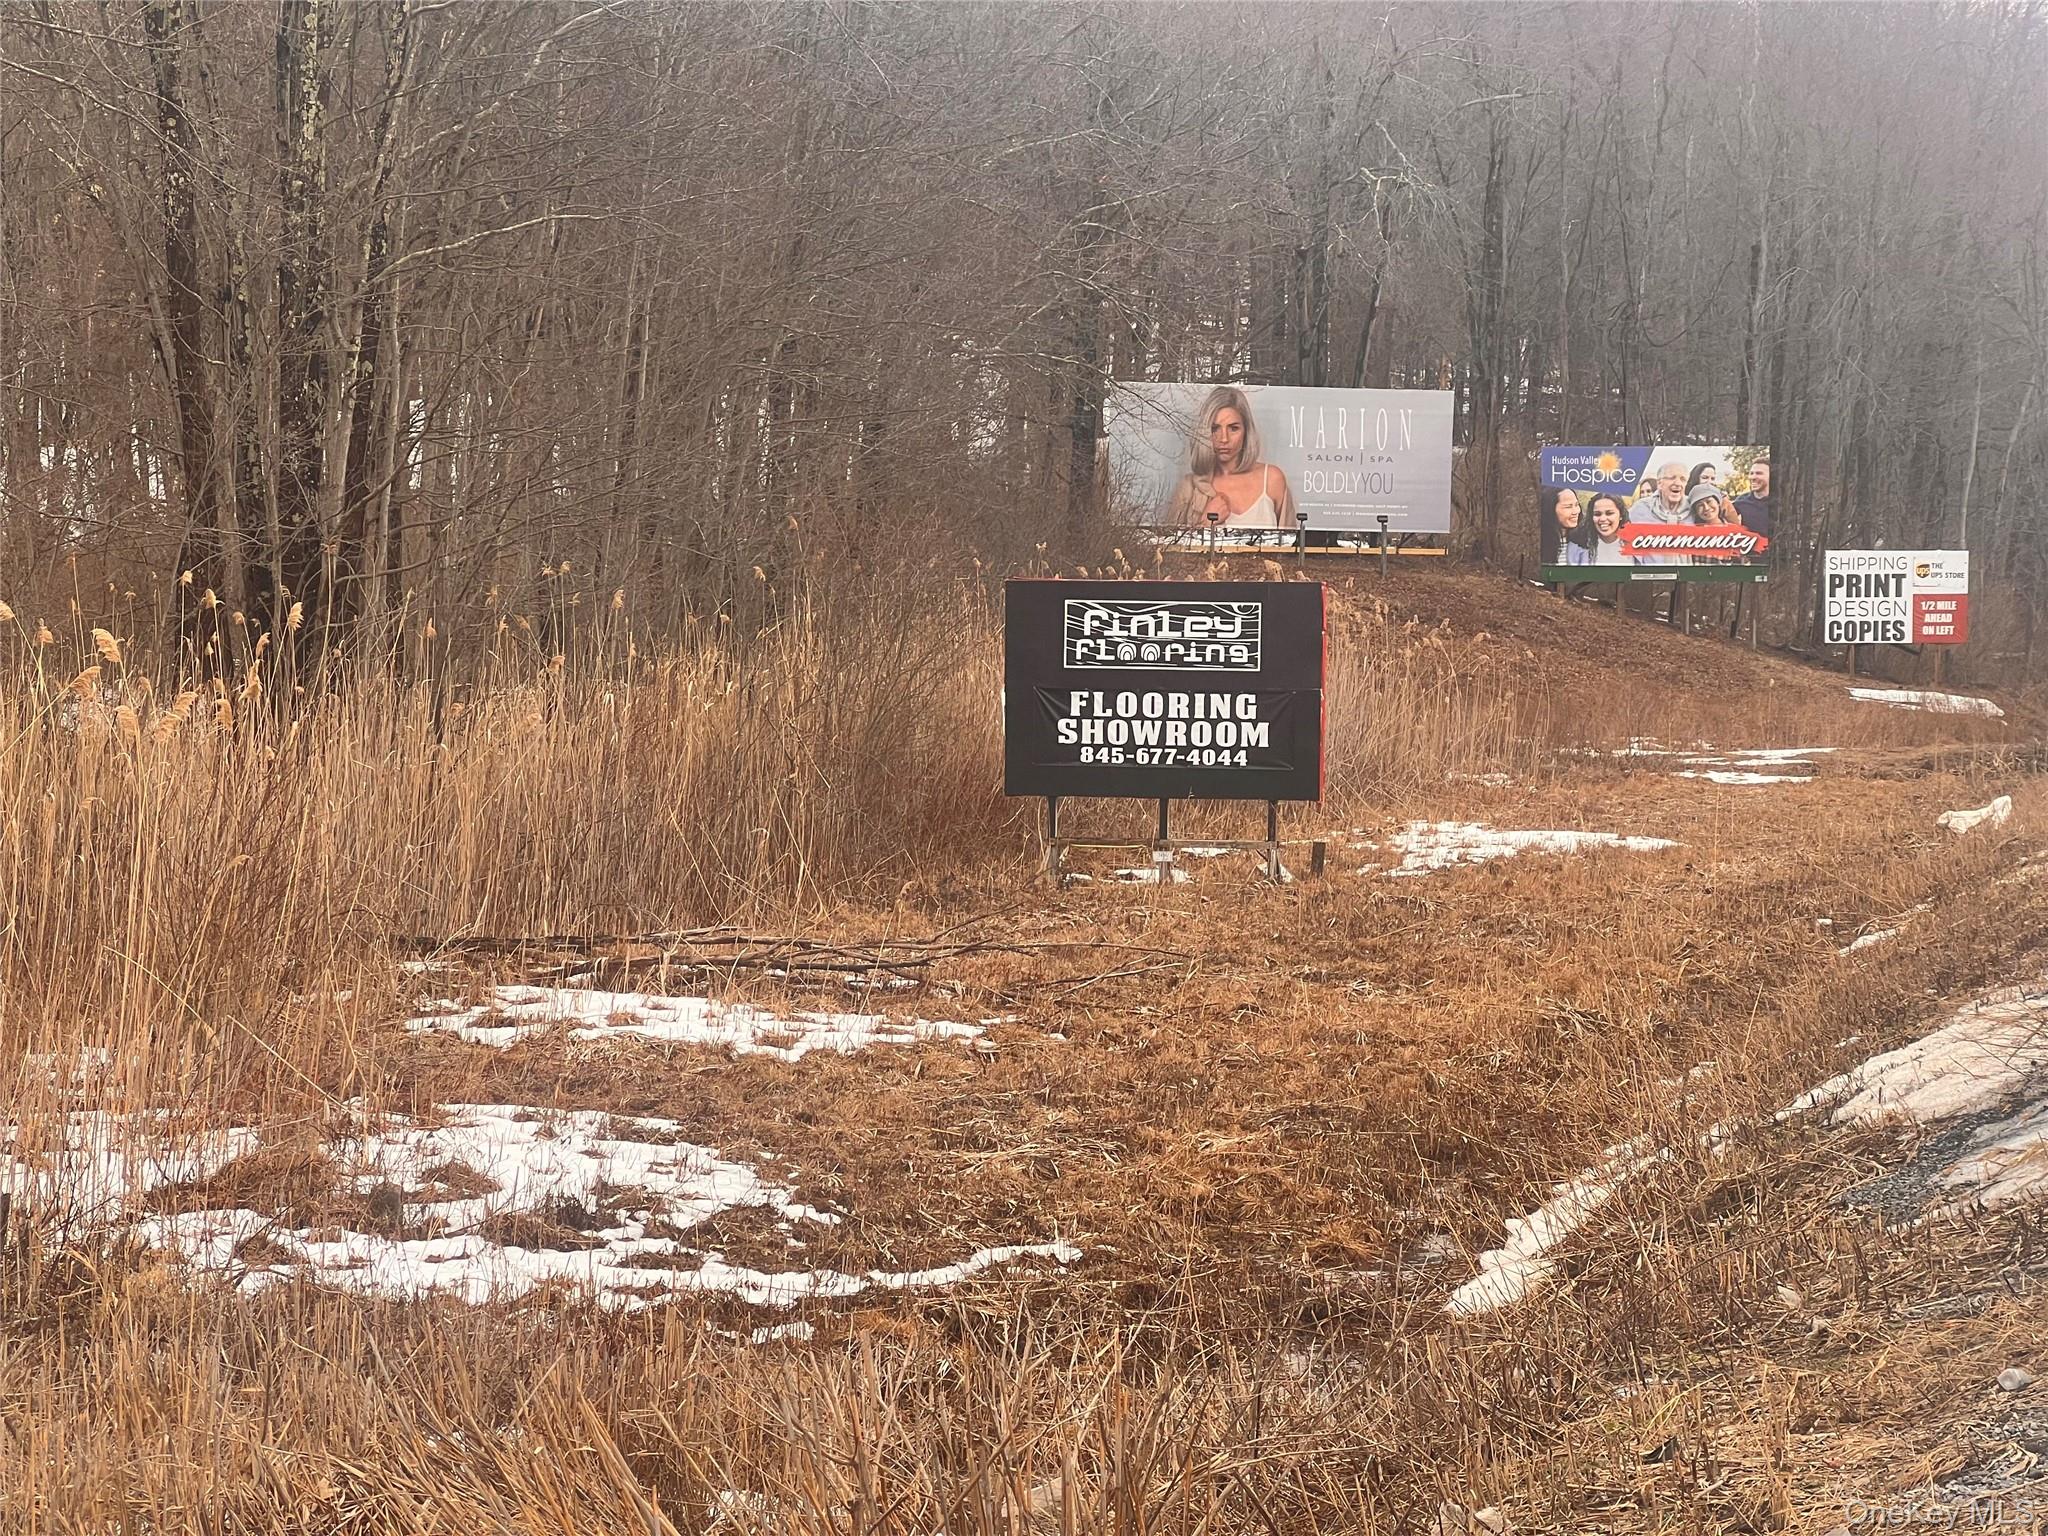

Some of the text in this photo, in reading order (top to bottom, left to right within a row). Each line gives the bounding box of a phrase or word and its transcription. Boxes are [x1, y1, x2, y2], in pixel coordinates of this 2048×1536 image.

[1289, 405, 1413, 451] MARION
[1307, 454, 1394, 464] SALON SPA
[1551, 455, 1579, 465] Hudson
[1551, 466, 1637, 485] Hospice
[1631, 532, 1758, 555] community
[1829, 556, 1908, 570] SHIPPING
[1829, 573, 1906, 598] PRINT
[1829, 601, 1907, 617] DESIGN
[1920, 601, 1957, 610] 1/2 MILE
[1924, 613, 1953, 622] AHEAD
[1828, 620, 1905, 642] COPIES
[1922, 626, 1955, 635] ON LEFT
[1070, 691, 1258, 719] FLOORING
[1057, 719, 1270, 748] SHOWROOM
[1080, 747, 1248, 767] 845-677-4044
